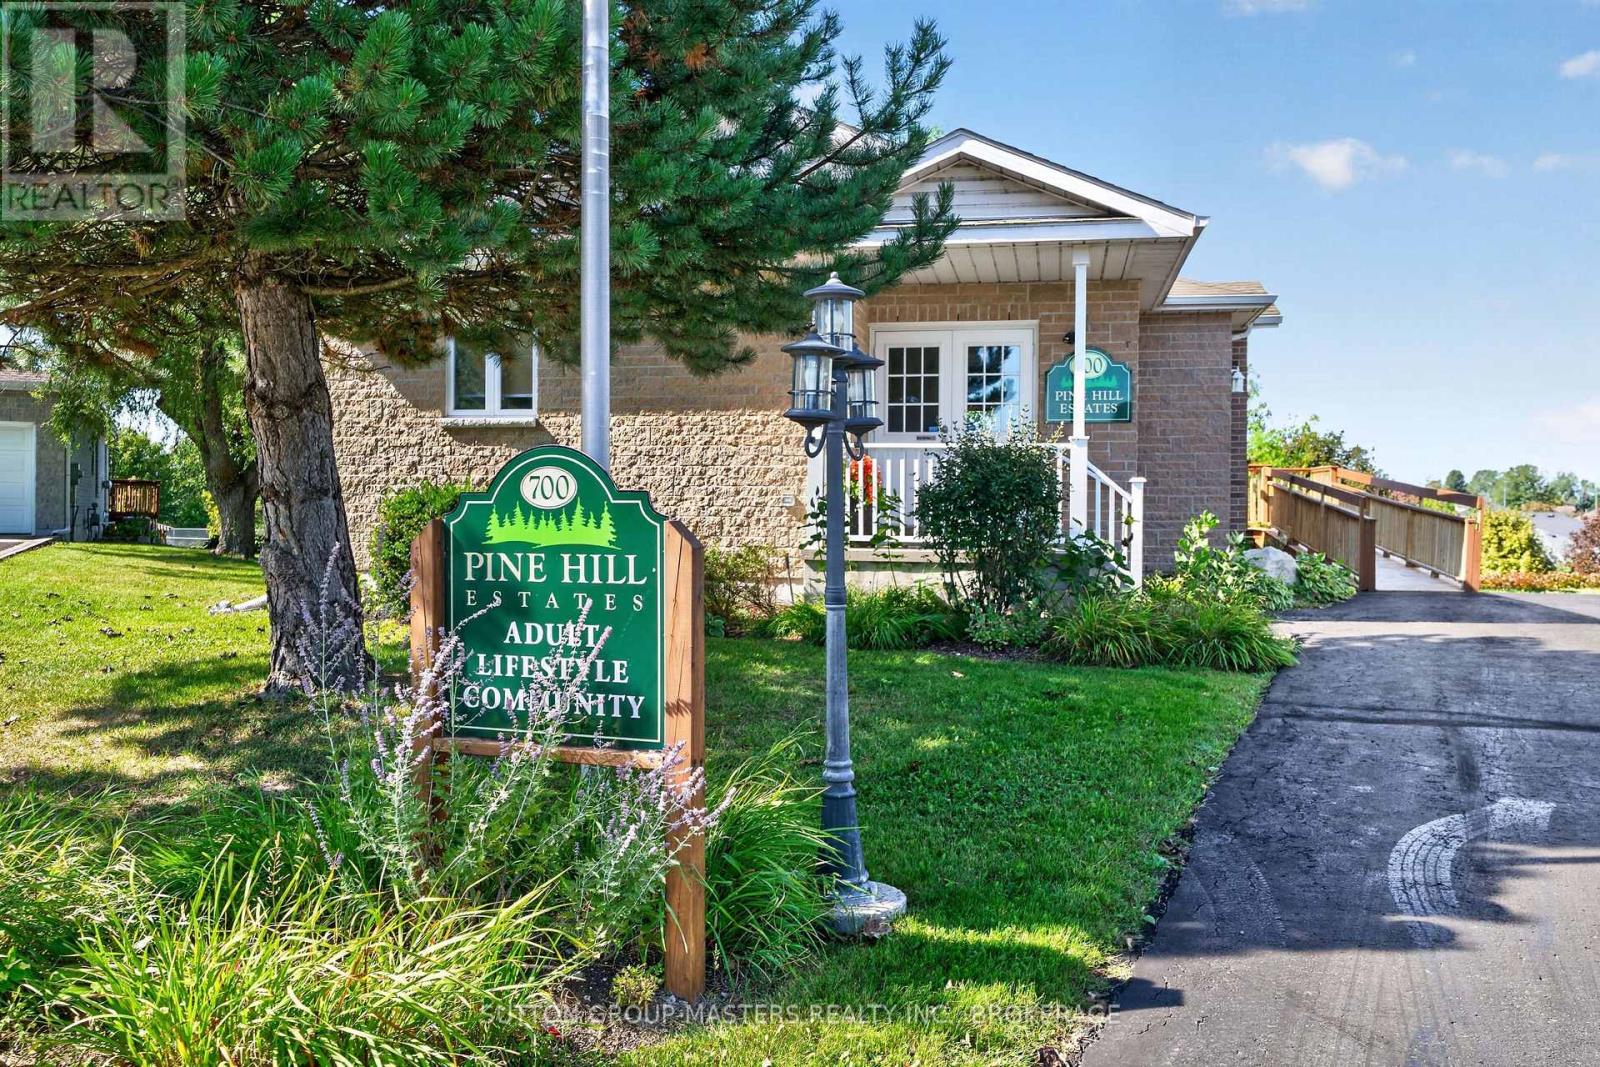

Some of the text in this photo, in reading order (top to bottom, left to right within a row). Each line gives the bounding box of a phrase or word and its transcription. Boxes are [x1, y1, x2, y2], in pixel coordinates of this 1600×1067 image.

[1060, 403, 1118, 414] ESATES
[1092, 390, 1124, 401] HILL
[529, 474, 570, 500] 700
[463, 552, 647, 585] PINE HILL
[466, 589, 644, 612] ESTATES
[503, 620, 600, 648] ADULT
[476, 652, 630, 684] LIFESTYLE
